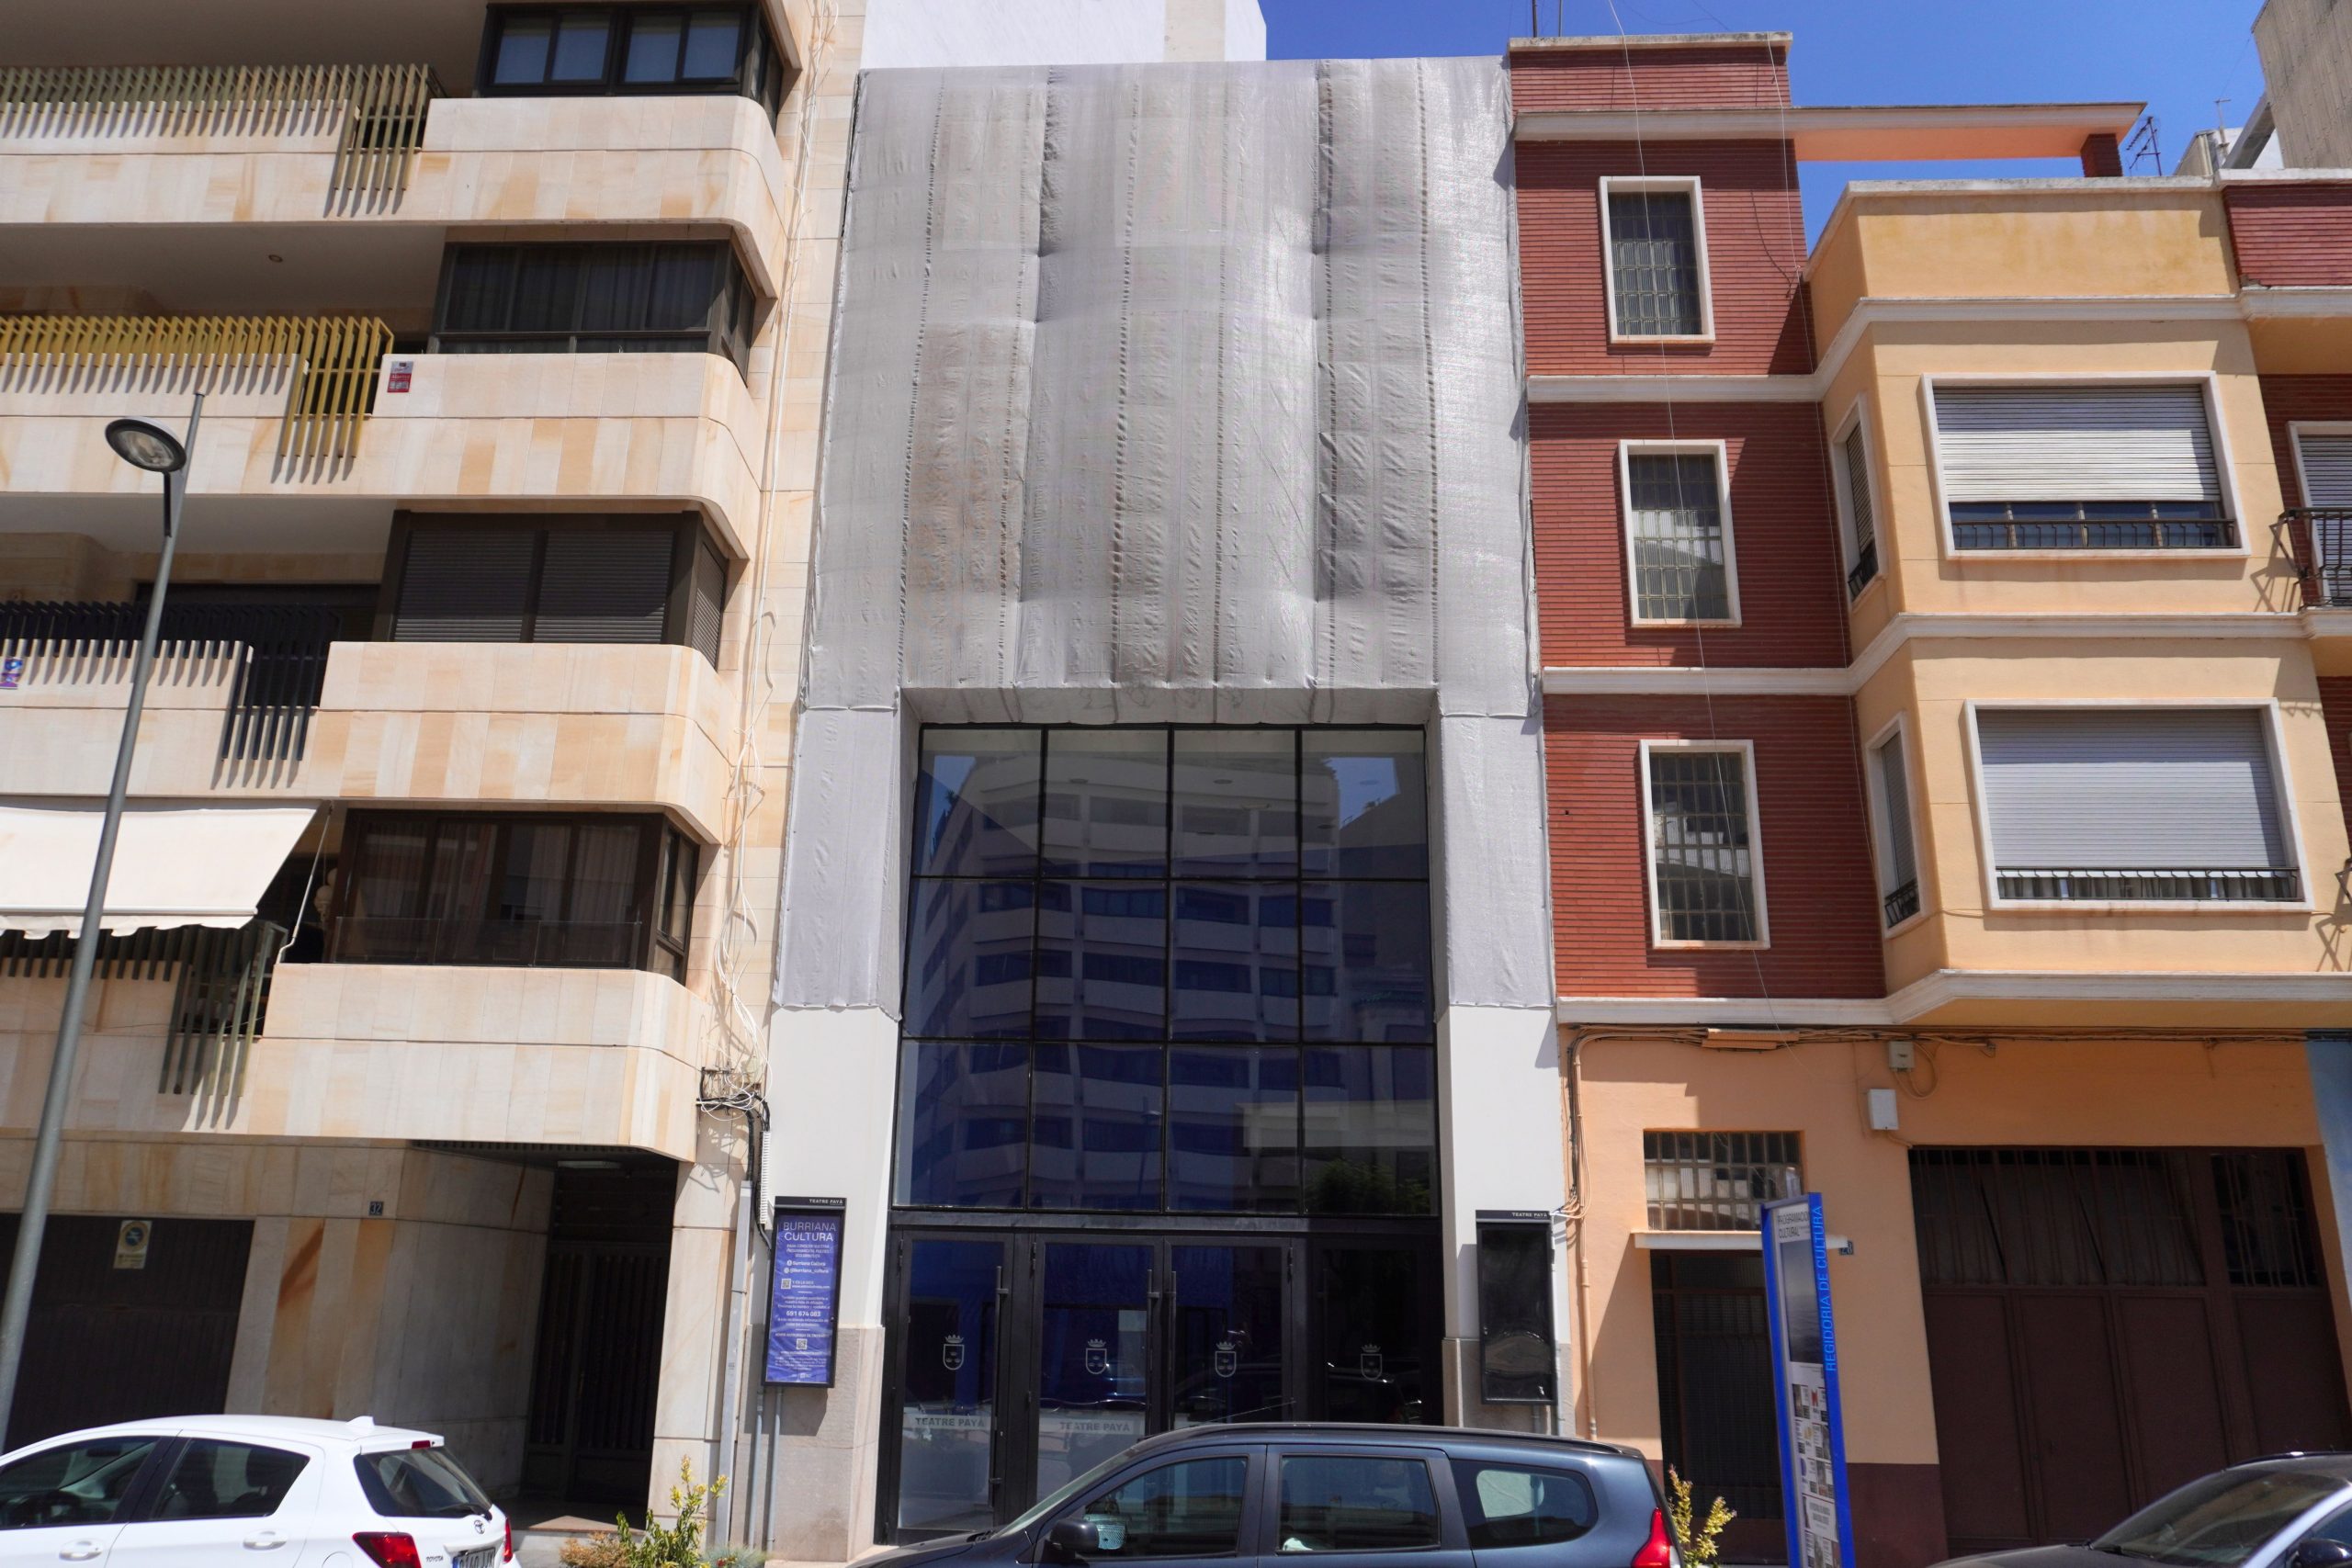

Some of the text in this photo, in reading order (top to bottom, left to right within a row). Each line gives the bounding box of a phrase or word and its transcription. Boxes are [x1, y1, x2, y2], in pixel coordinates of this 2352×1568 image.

[783, 1222, 836, 1232] BURRIANA
[784, 1232, 834, 1241] CULTURA
[1812, 1205, 1837, 1371] REGIDORIA DE CULTURA
[915, 1417, 955, 1427] TEATRE
[1059, 1422, 1101, 1431] TEATRE
